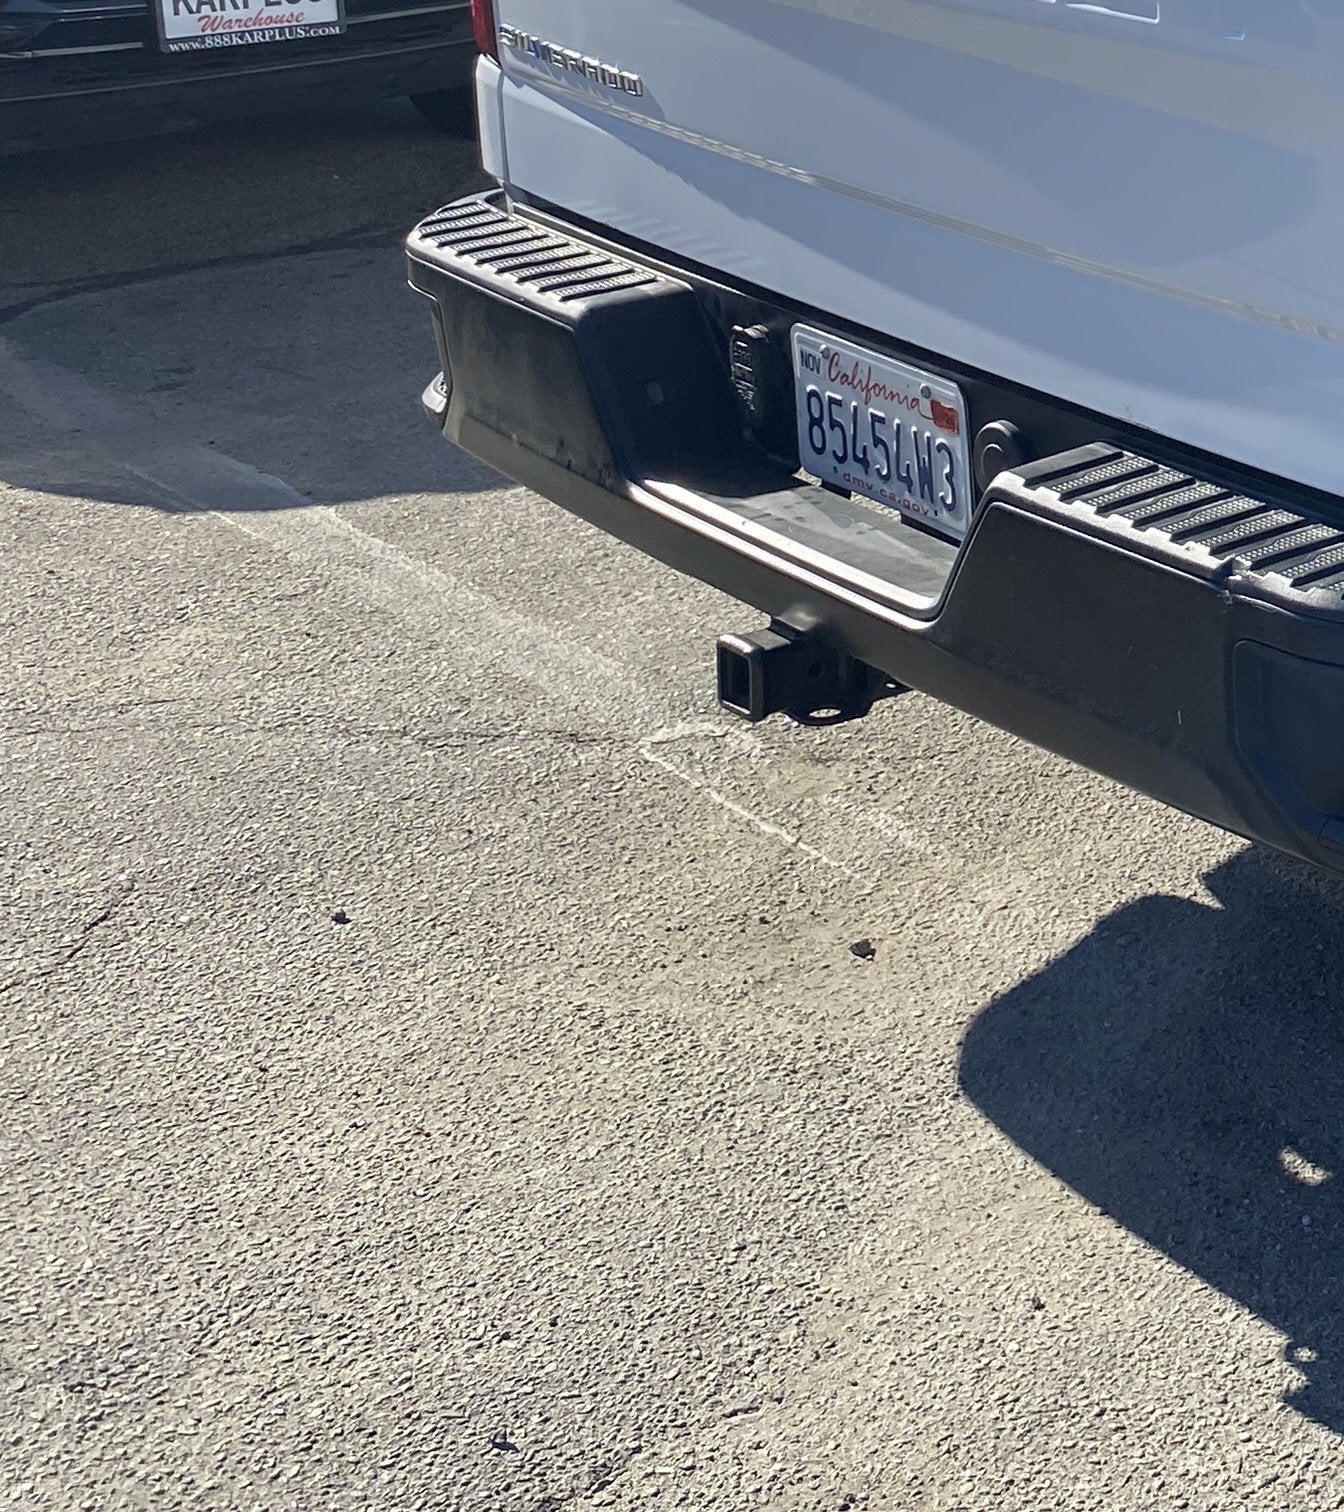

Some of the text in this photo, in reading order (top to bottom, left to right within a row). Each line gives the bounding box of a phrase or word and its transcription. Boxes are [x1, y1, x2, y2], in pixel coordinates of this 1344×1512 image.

[197, 8, 305, 33] Warehouse
[800, 349, 821, 375] NOV
[828, 352, 934, 420] California
[806, 384, 957, 512] 85454W3
[843, 472, 929, 516] dmv.ca.gov
